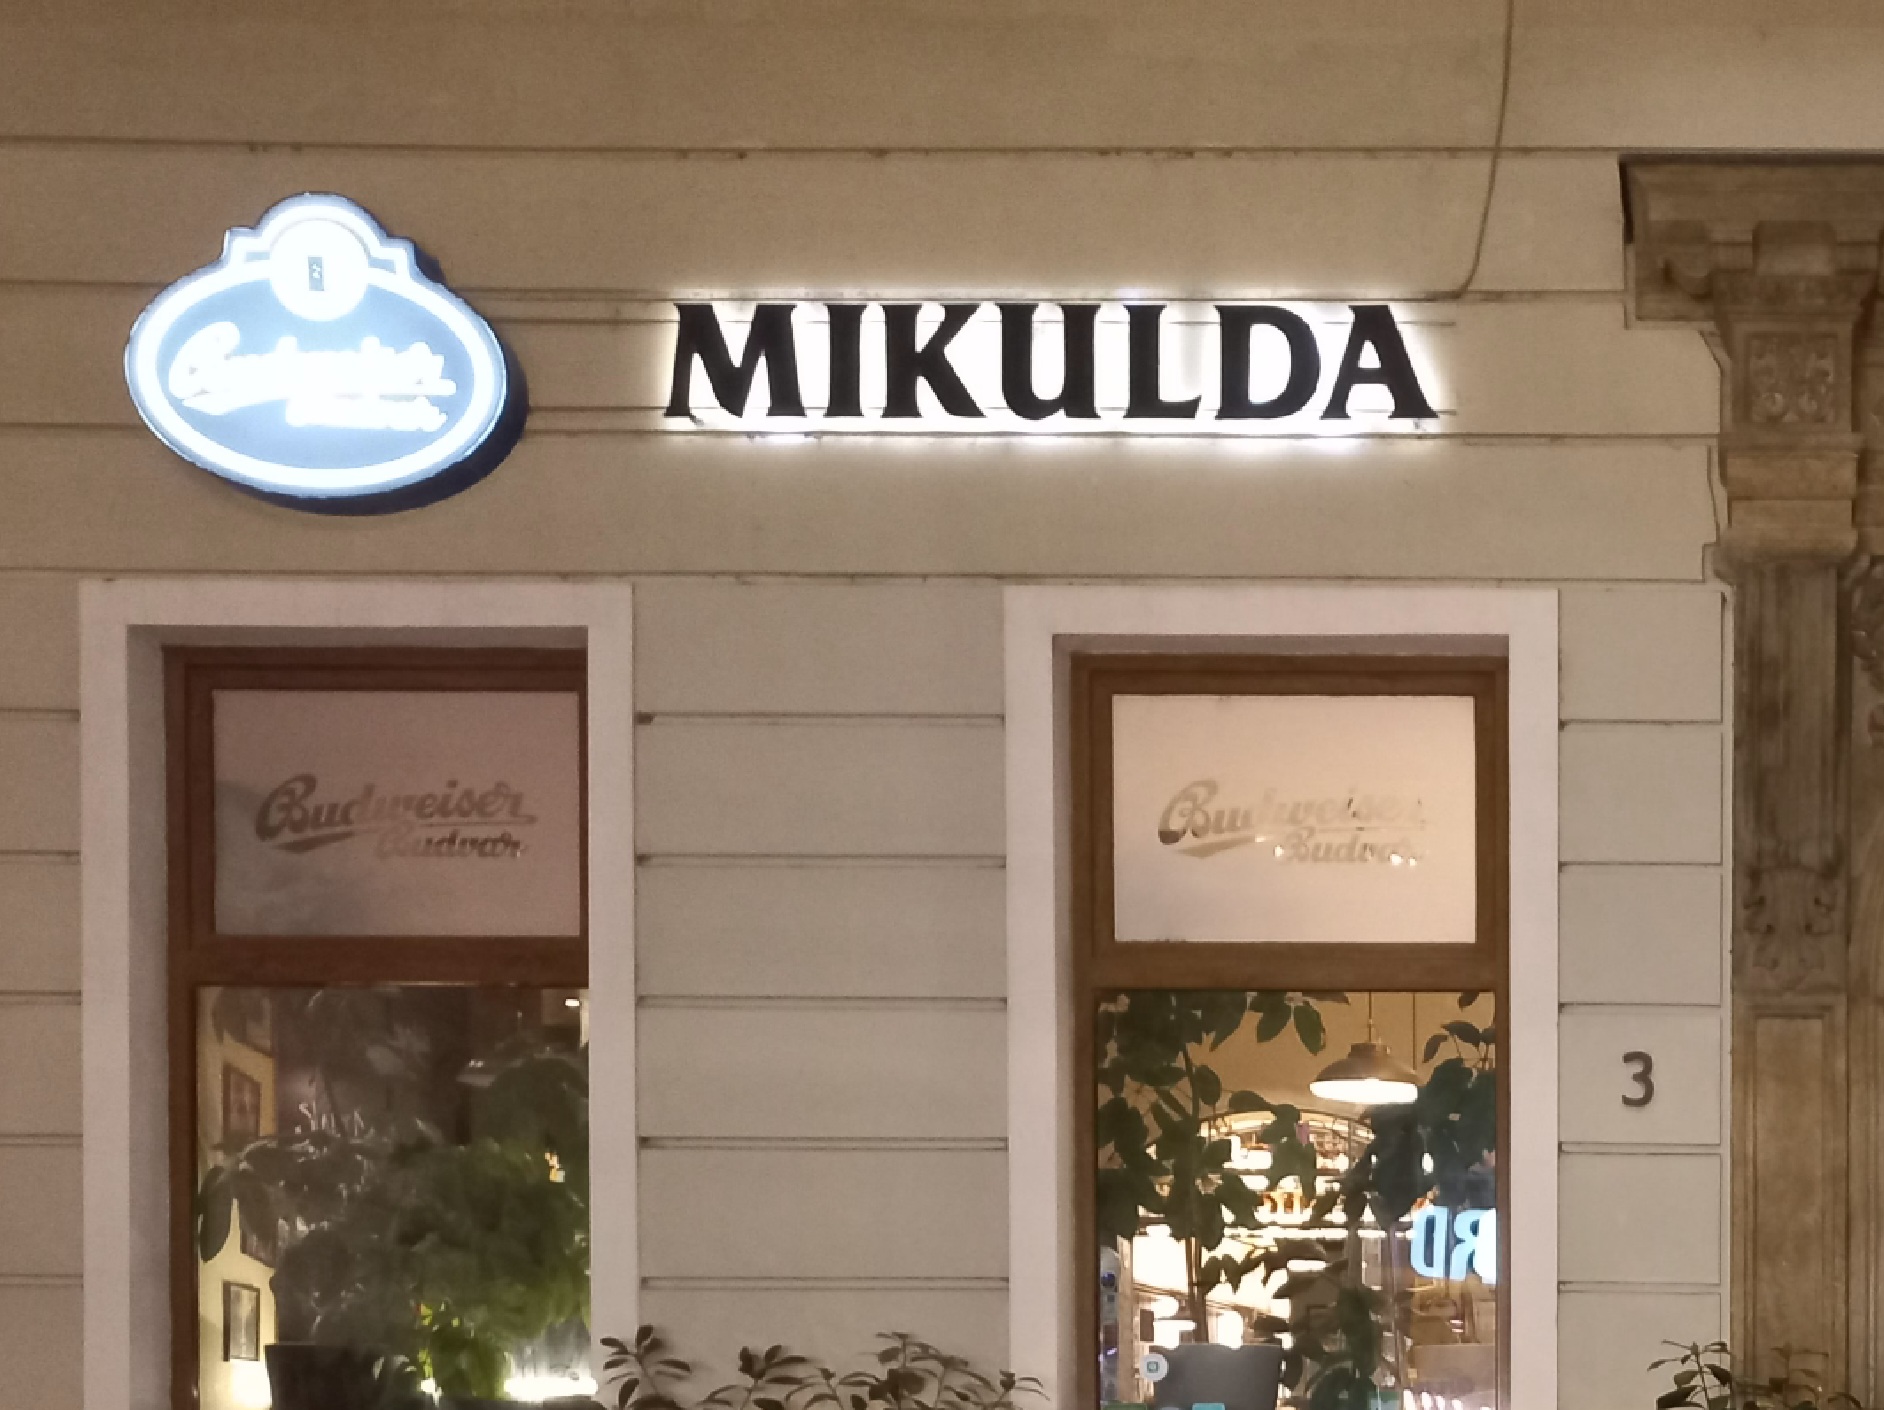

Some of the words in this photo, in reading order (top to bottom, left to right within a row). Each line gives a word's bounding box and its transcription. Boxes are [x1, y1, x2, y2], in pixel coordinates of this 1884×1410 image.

[664, 303, 1441, 422] MIKULDA
[255, 773, 538, 845] Budweiser
[1620, 1050, 1655, 1108] 3
